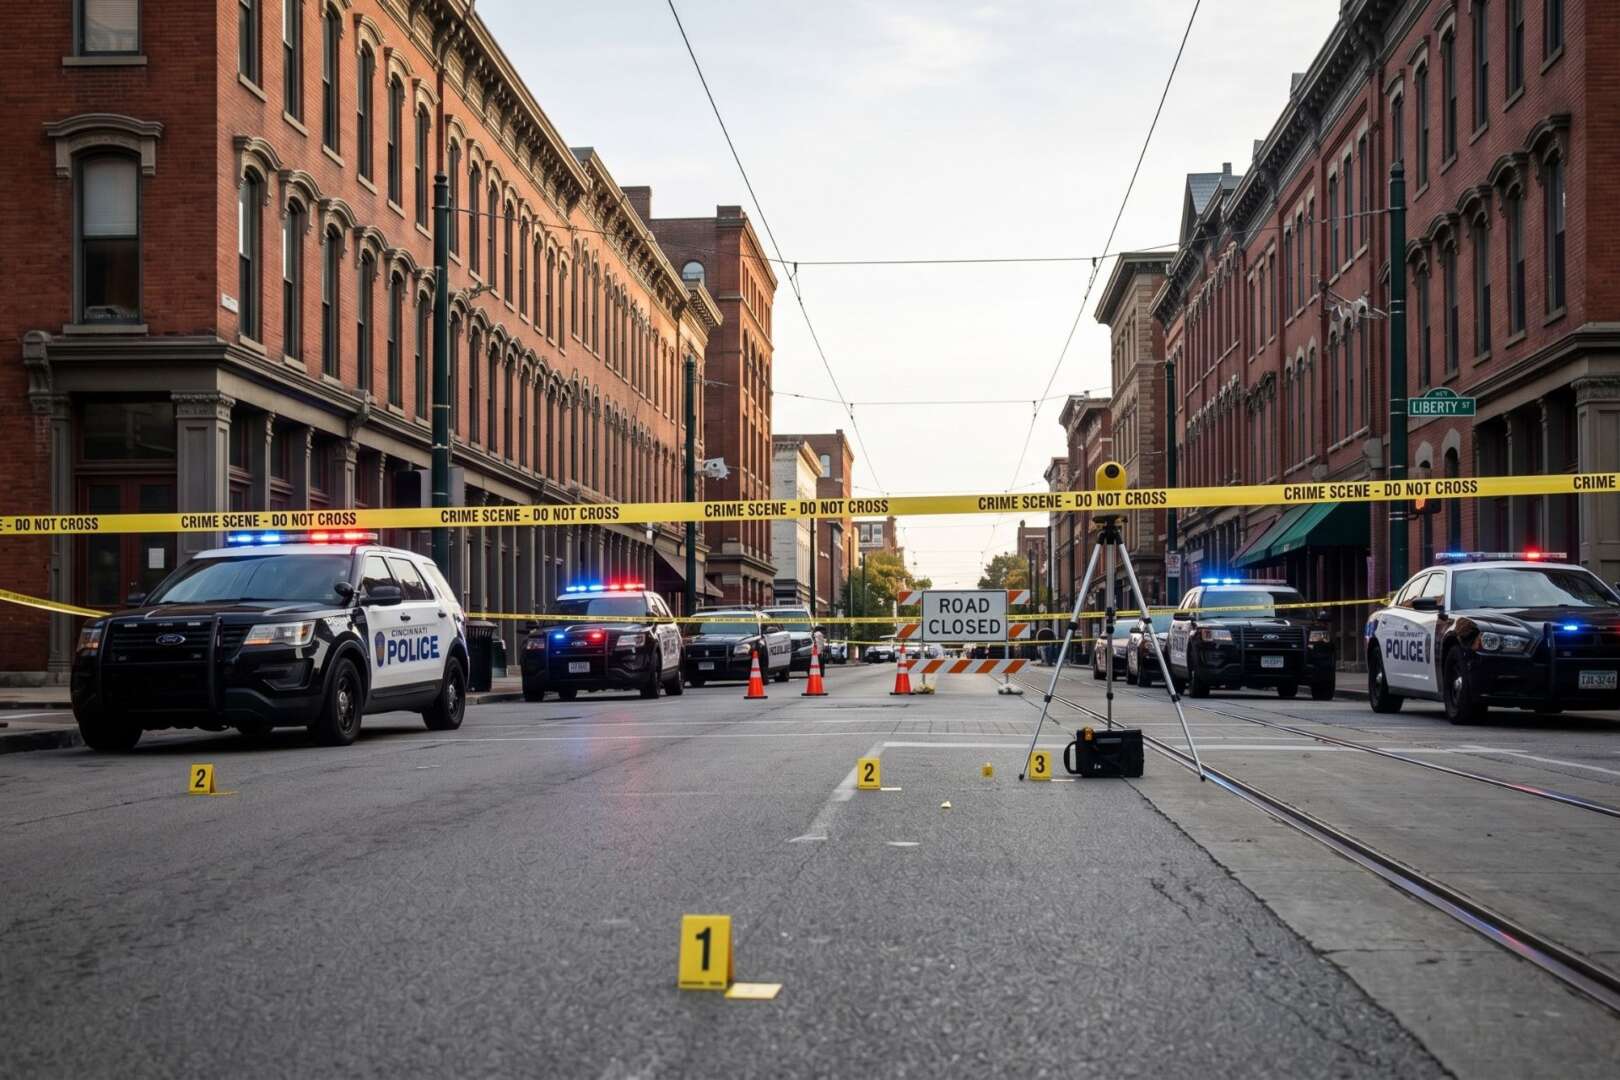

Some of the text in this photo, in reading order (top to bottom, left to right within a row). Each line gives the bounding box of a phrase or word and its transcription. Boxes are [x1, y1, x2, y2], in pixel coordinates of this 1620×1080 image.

[1413, 401, 1458, 413] LIBERTY
[1284, 486, 1325, 500] CRIME
[1330, 484, 1370, 499] SCENE
[1384, 483, 1401, 496] DO
[1406, 482, 1431, 495] NOT
[1435, 480, 1477, 494] CROSS
[1573, 475, 1616, 489] CRIME
[705, 503, 744, 517] CRIME
[748, 503, 786, 516] SCENE
[800, 502, 816, 514] DO
[821, 501, 844, 514] NOT
[848, 500, 888, 513] CROSS
[978, 496, 1018, 510] CRIME
[1022, 495, 1062, 509] SCENE
[1076, 494, 1092, 507] DO
[1097, 493, 1121, 506] NOT
[1125, 491, 1167, 505] CROSS
[16, 518, 30, 530] DO
[34, 518, 56, 530] NOT
[60, 517, 98, 530] CROSS
[181, 515, 219, 528] CRIME
[223, 514, 259, 527] SCENE
[272, 514, 287, 526] DO
[292, 513, 314, 525] NOT
[318, 512, 356, 525] CROSS
[441, 510, 478, 523] CRIME
[482, 509, 520, 522] SCENE
[533, 508, 548, 521] DO
[553, 508, 576, 520] NOT
[580, 507, 619, 520] CROSS
[939, 598, 990, 613] ROAD
[391, 627, 428, 637] CINCINNATI
[929, 619, 1000, 634] CLOSED
[387, 635, 440, 665] POLICE
[1386, 639, 1424, 662] POLICE
[864, 763, 874, 782] 2
[1035, 755, 1045, 773] 3
[195, 768, 206, 788] 2
[696, 926, 711, 971] 1
